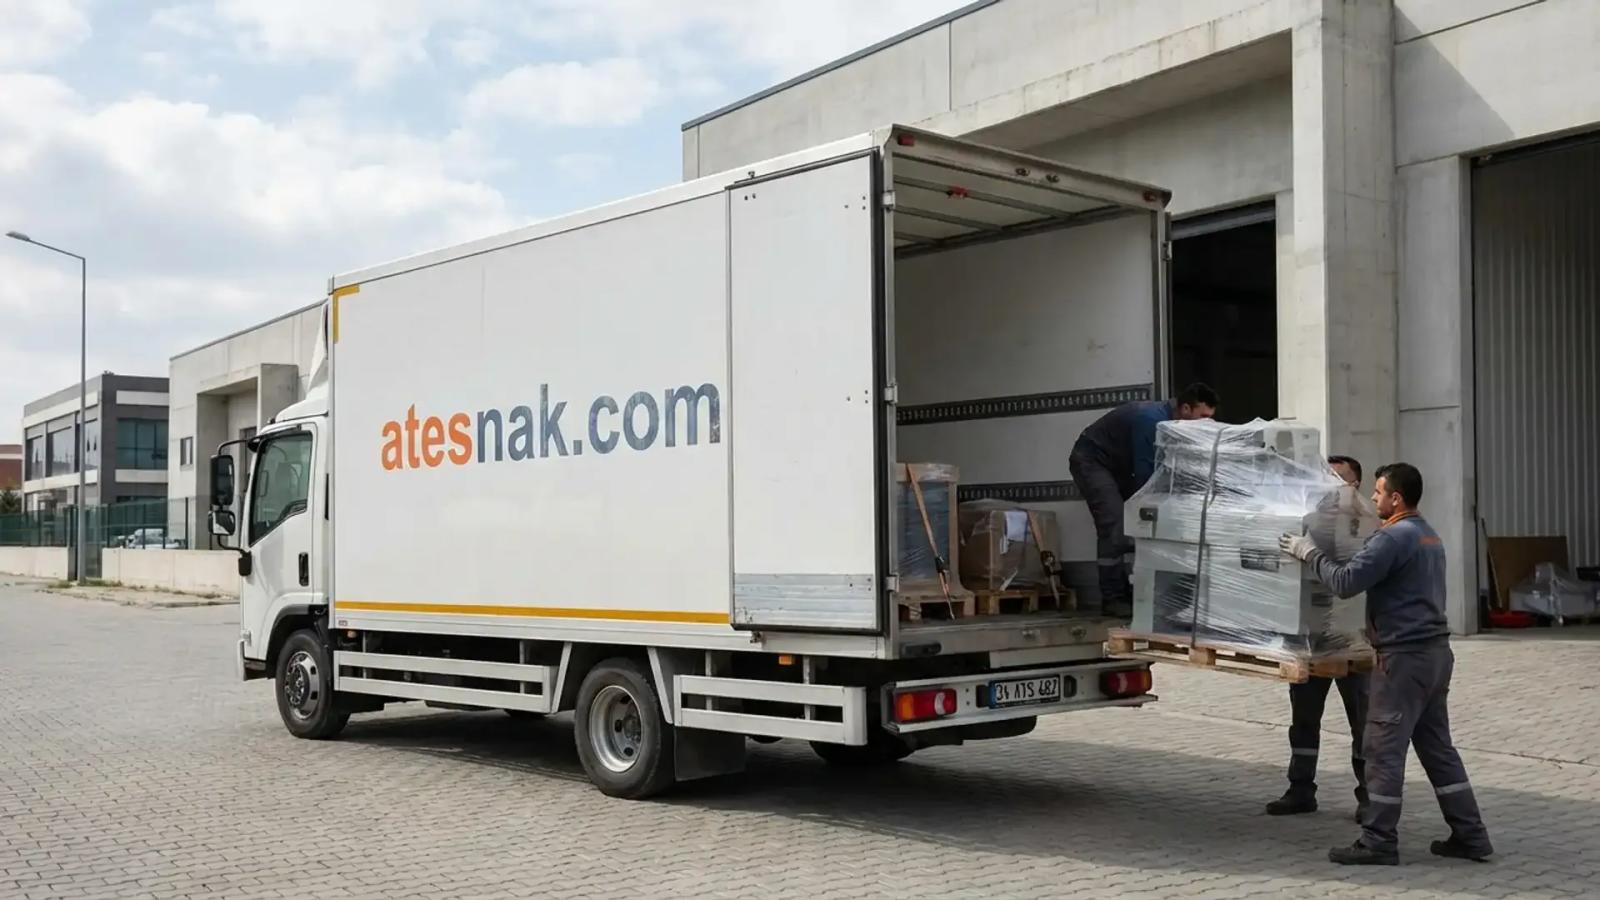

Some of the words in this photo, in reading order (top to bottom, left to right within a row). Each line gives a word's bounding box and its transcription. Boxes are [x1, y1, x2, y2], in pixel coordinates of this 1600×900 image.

[381, 383, 721, 471] atesnak.com
[996, 684, 1009, 701] 34
[1015, 682, 1034, 698] ATS
